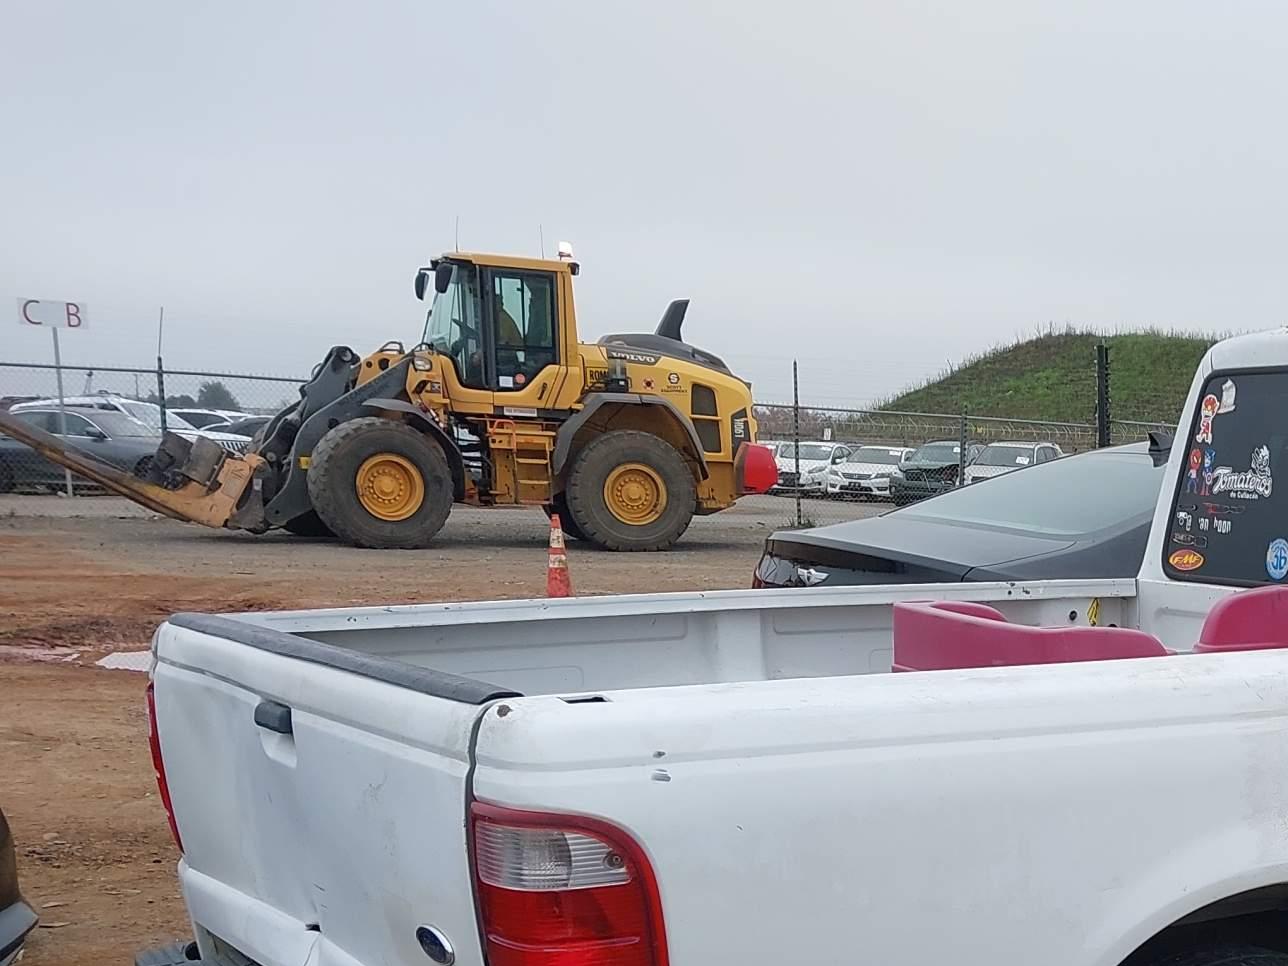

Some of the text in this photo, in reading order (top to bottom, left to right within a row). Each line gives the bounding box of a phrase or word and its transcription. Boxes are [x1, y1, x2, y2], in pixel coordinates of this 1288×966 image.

[23, 299, 82, 328] C B
[610, 351, 656, 363] VOLVO
[1213, 466, 1272, 497] Tomateros
